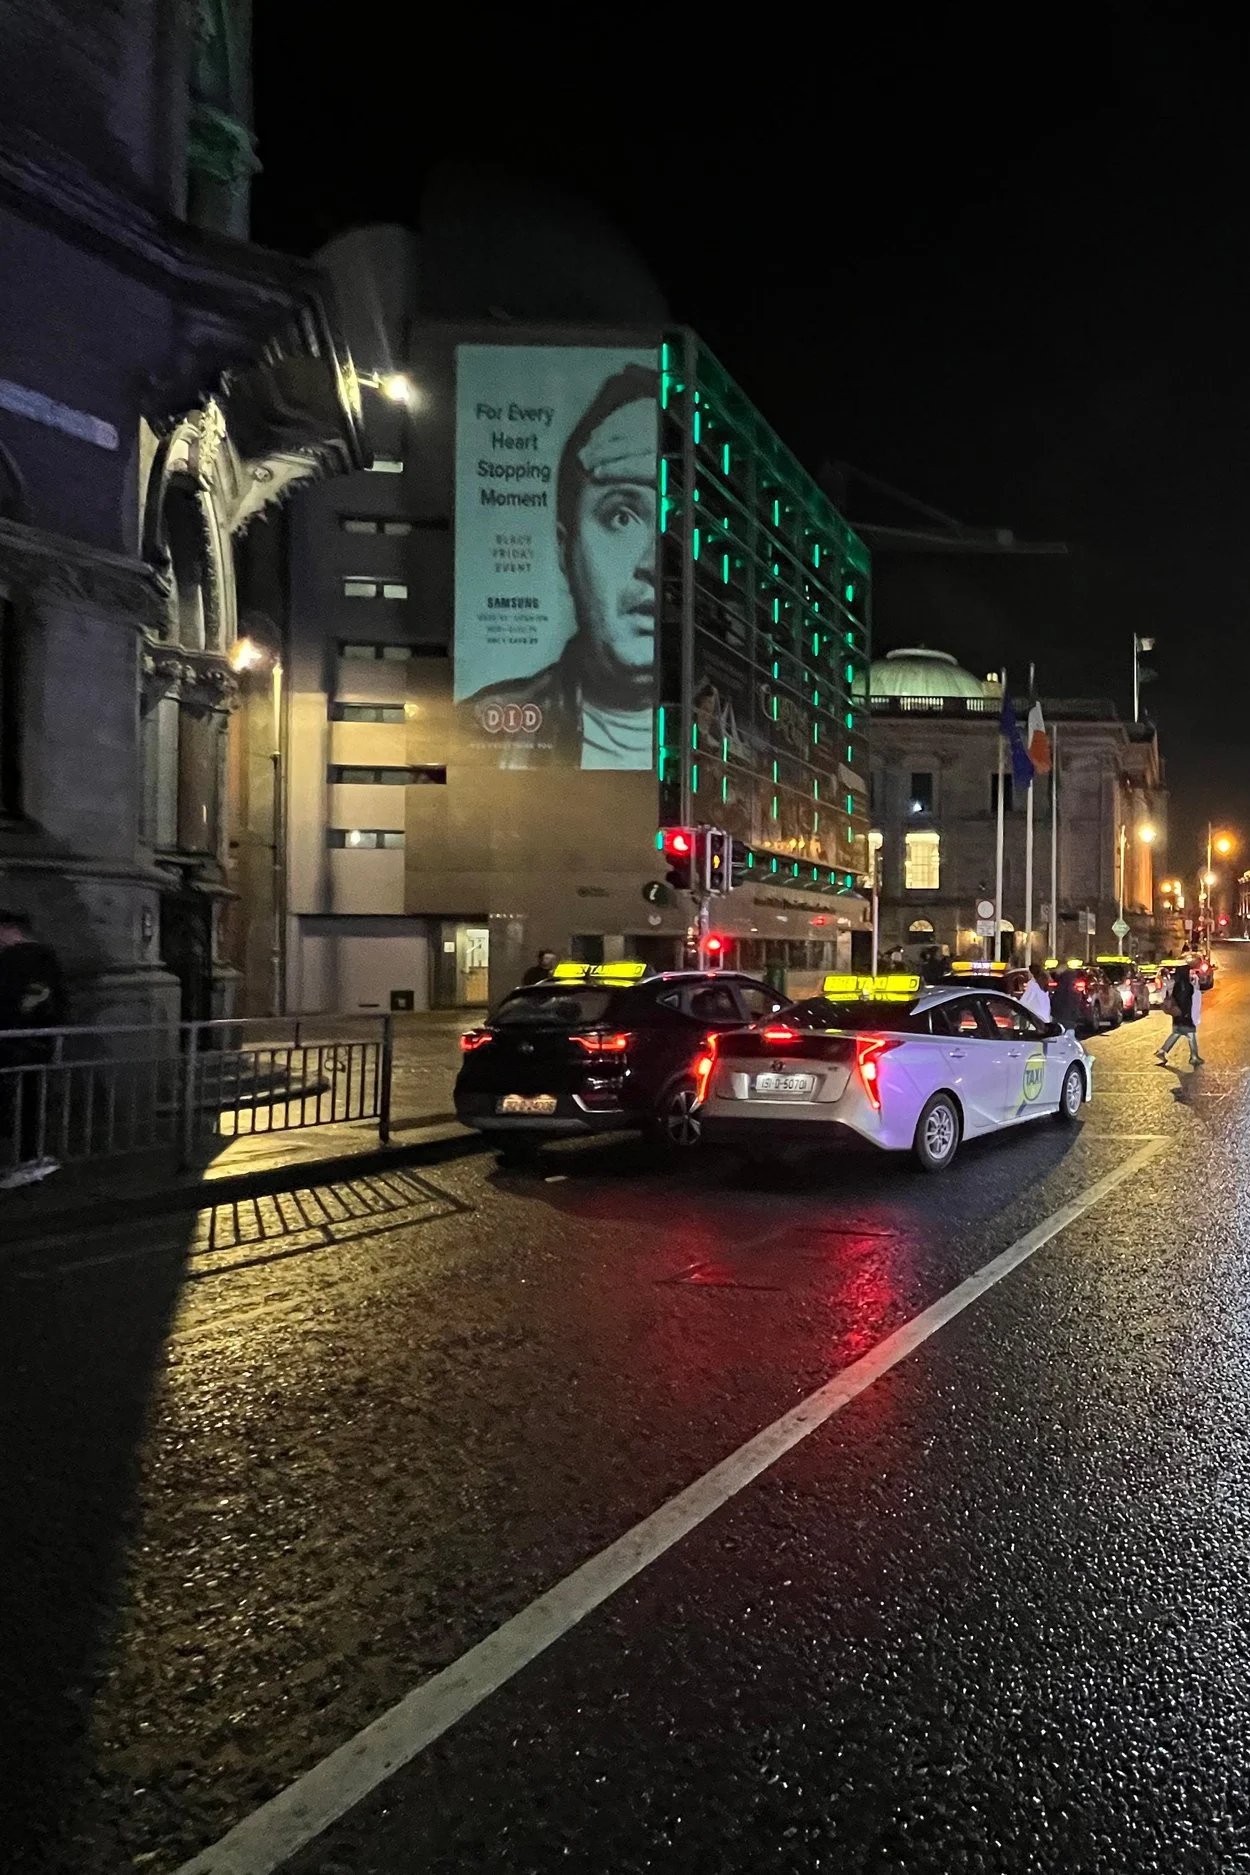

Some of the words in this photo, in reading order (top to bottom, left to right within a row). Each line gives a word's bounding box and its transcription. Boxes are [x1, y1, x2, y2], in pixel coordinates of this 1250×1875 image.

[476, 403, 502, 420] For
[508, 403, 554, 426] Every
[492, 432, 538, 450] Heart
[477, 460, 551, 482] Stopping
[481, 489, 547, 507] Moment
[487, 597, 539, 609] SAMSUNG
[1025, 1068, 1043, 1086] TAXI
